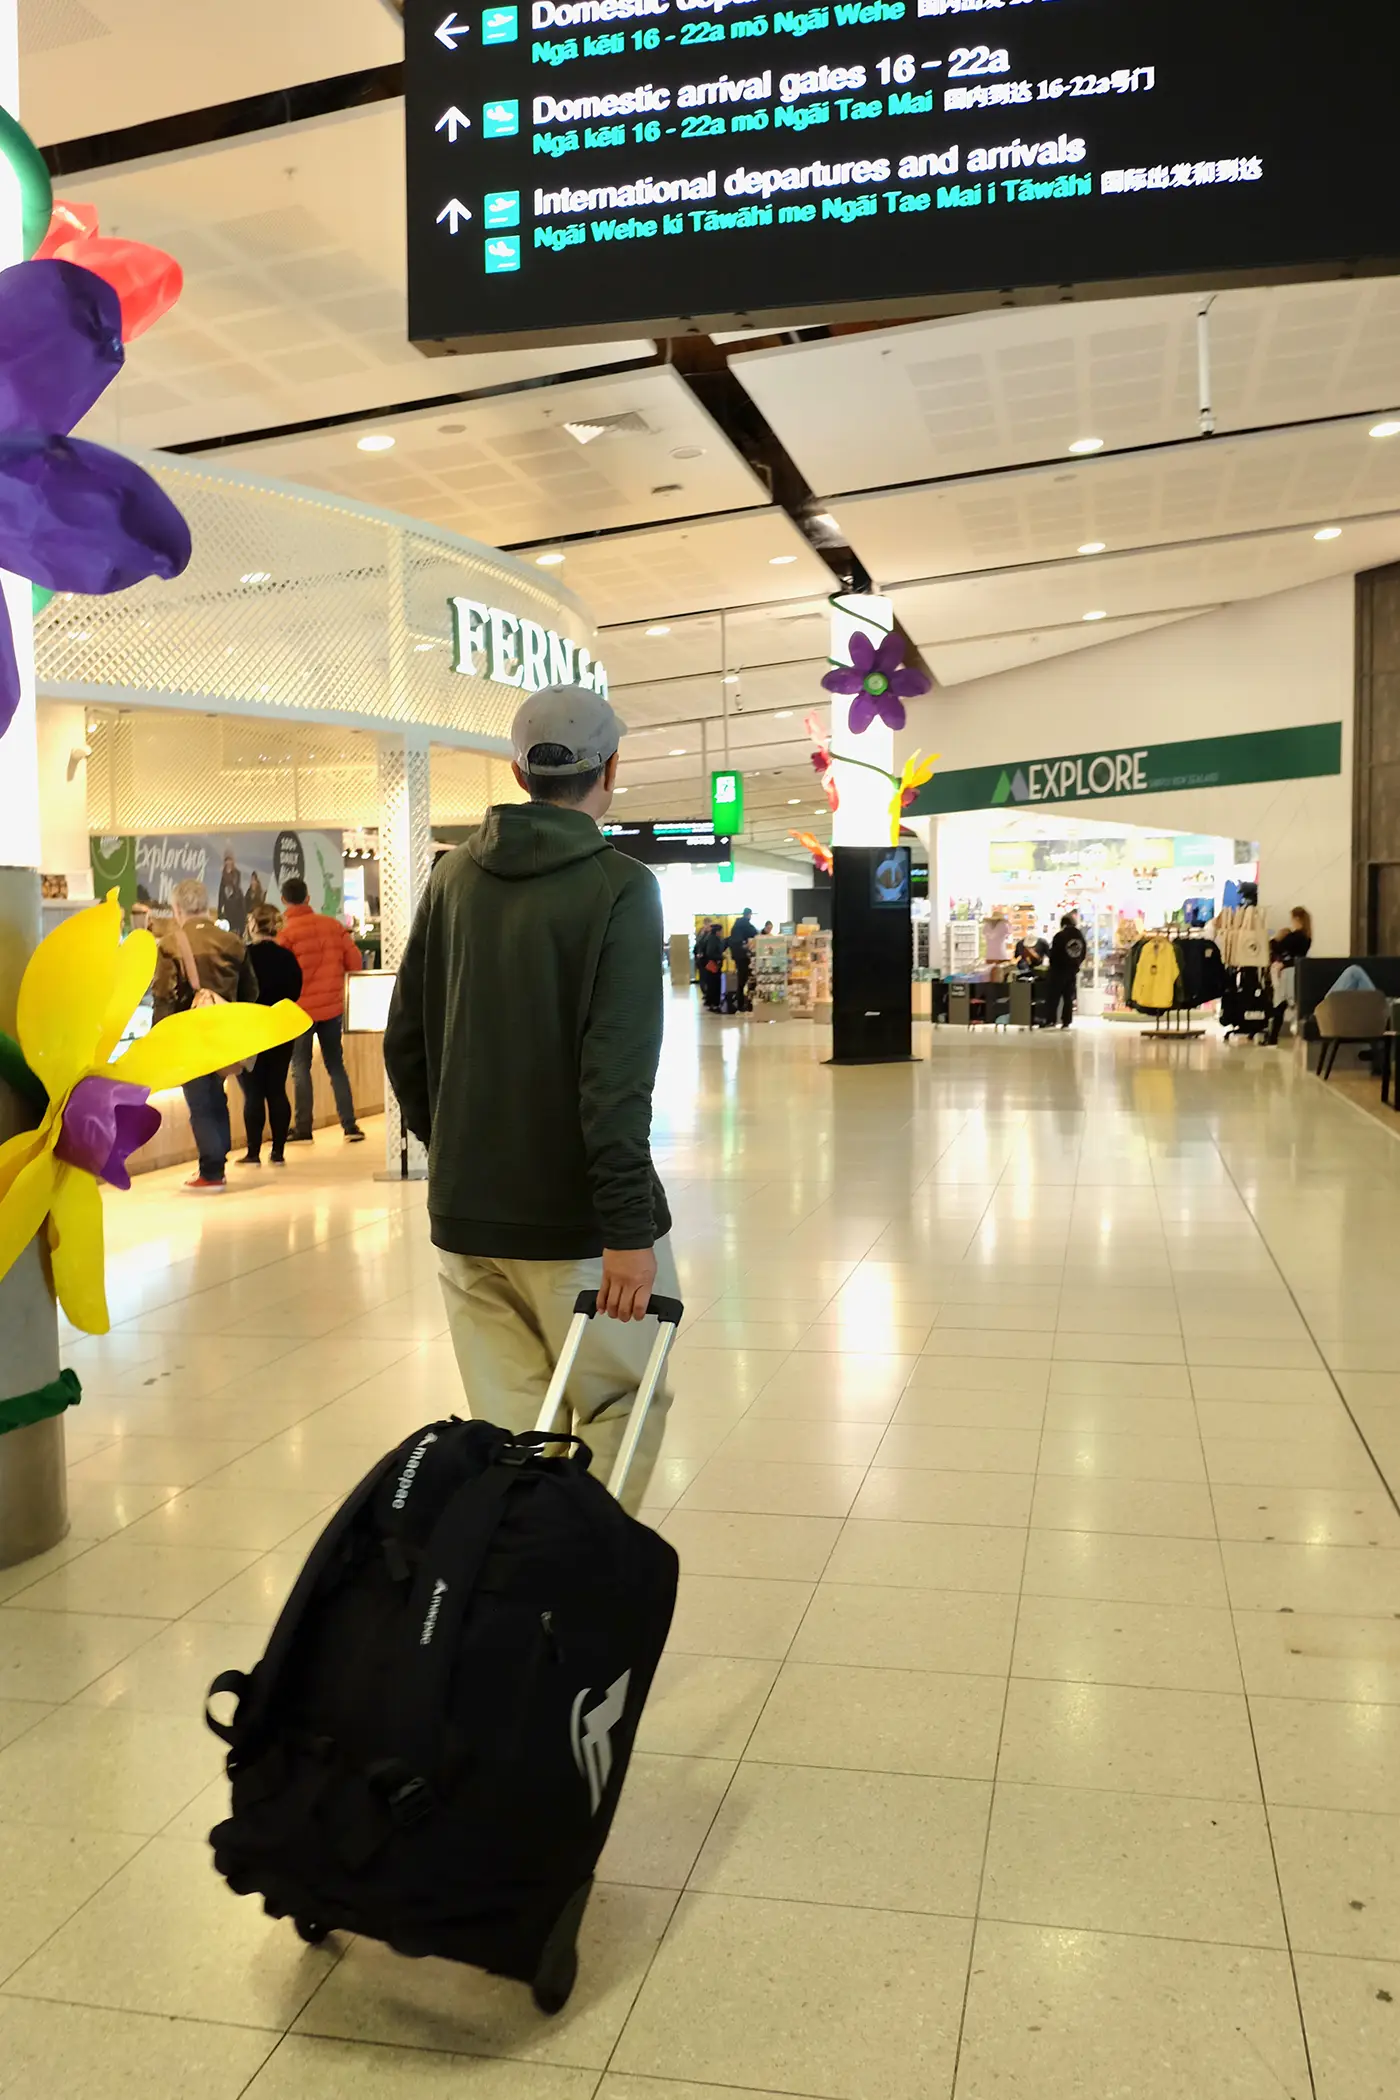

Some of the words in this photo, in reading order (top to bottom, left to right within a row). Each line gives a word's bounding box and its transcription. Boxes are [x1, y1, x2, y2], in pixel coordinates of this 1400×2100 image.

[532, 39, 579, 66] Ngā
[584, 32, 624, 57] kēti
[631, 28, 660, 50] 16
[680, 22, 725, 45] 22a
[731, 15, 768, 39] mō
[774, 7, 829, 36] Ngāi
[835, 0, 905, 26] Wehe
[533, 84, 670, 124] Domestic
[677, 70, 771, 107] arrival
[779, 65, 866, 102] gates
[876, 54, 915, 85] 16
[948, 46, 1010, 77] 22a
[533, 130, 580, 157] Ngā
[585, 124, 625, 148] kēti
[633, 121, 661, 143] 16
[681, 115, 726, 138] 22a
[732, 109, 769, 132] mō
[775, 101, 829, 131] Ngāi
[834, 99, 882, 120] Tae
[888, 90, 932, 115] Mai
[534, 170, 716, 215] International
[724, 158, 891, 197] departures
[898, 145, 958, 179] and
[967, 133, 1086, 172] arrivals
[534, 223, 585, 251] Ngāi
[591, 218, 657, 242] Wehe
[663, 213, 683, 235] ki
[688, 204, 772, 232] Tāwāhi
[779, 205, 816, 223] me
[822, 194, 877, 223] Ngāi
[882, 191, 931, 213] Tae
[937, 184, 981, 208] Mai
[988, 182, 995, 204] i
[1001, 174, 1091, 202] Tāwāhi
[1028, 751, 1148, 800] EXPLORE
[135, 836, 209, 882] Exploring
